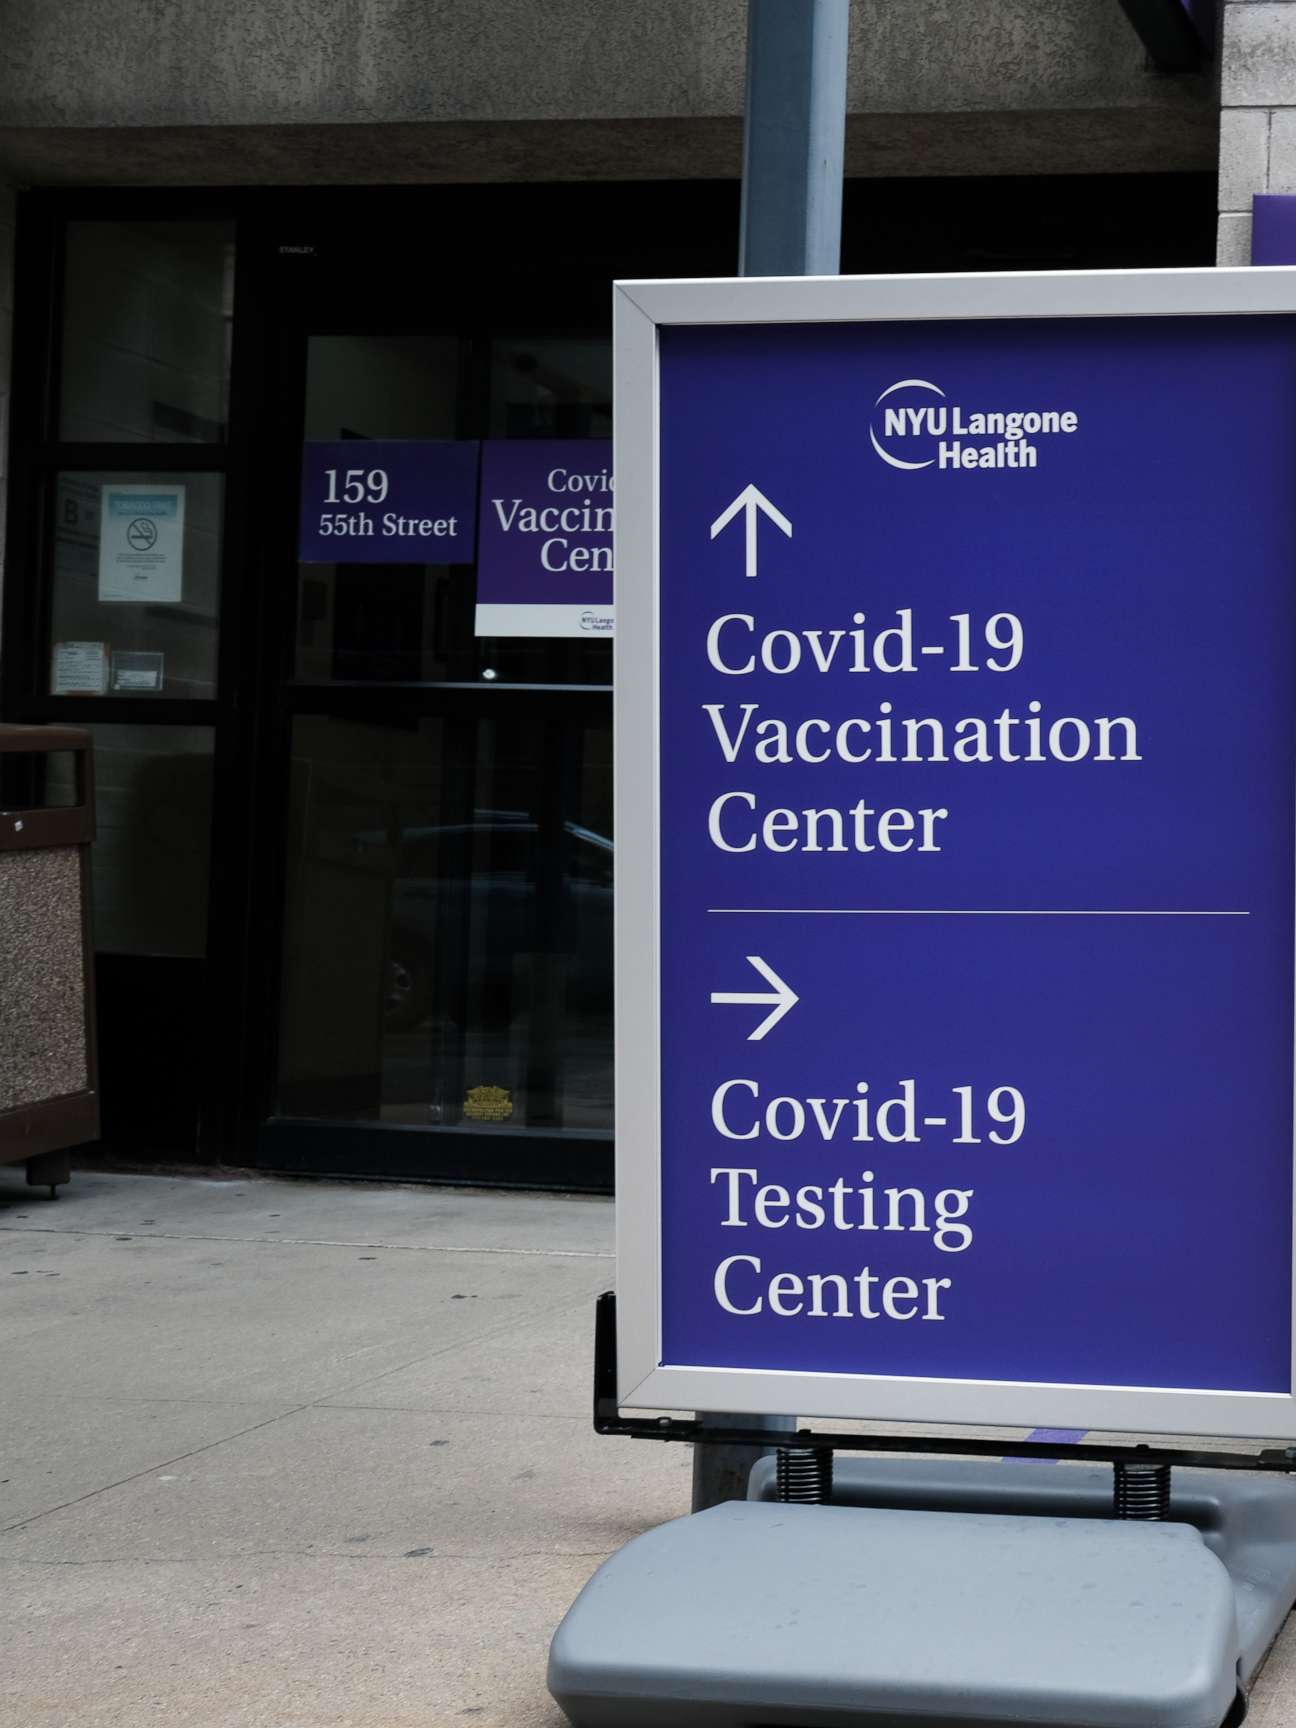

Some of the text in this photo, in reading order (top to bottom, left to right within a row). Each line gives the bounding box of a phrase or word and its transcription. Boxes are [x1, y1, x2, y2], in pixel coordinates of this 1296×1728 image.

[885, 406, 1078, 441] NYU Langone
[938, 439, 1037, 469] Health
[323, 469, 388, 504] 159
[319, 512, 458, 537] 55th Street
[706, 608, 1024, 675] Covid-19
[702, 700, 1142, 763] Vaccination
[708, 791, 948, 853] Center
[711, 1079, 1026, 1145] Covid-19
[710, 1167, 974, 1253] Testing
[714, 1254, 952, 1321] Center
